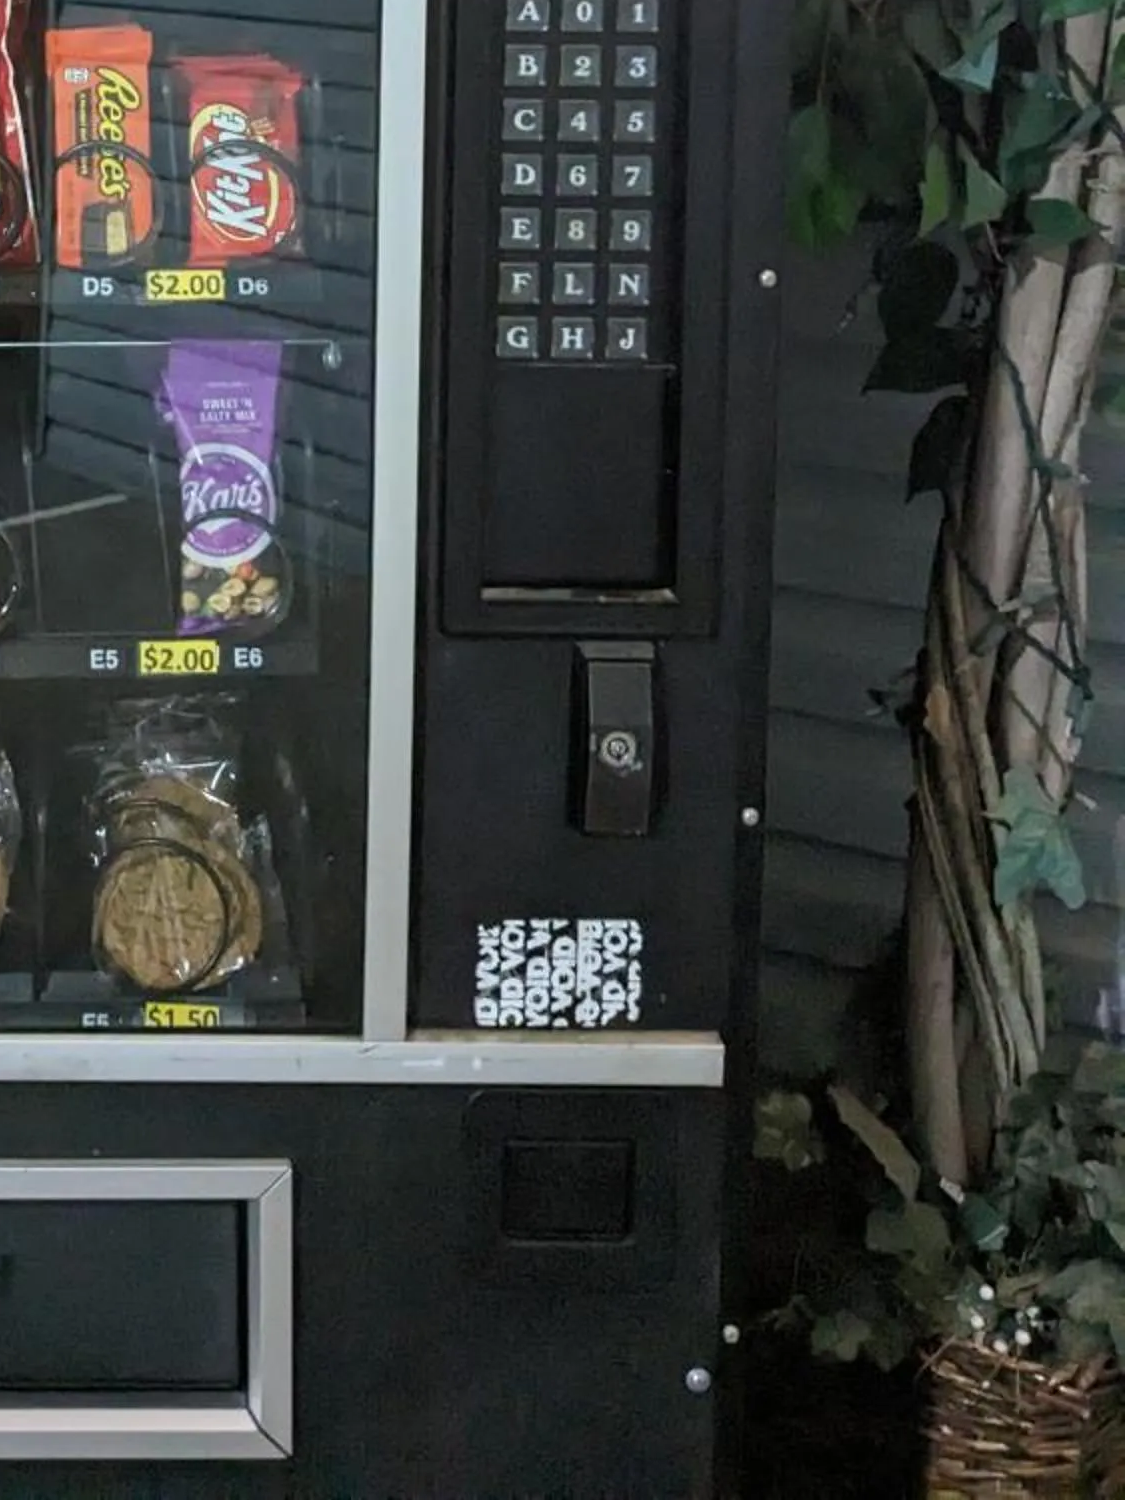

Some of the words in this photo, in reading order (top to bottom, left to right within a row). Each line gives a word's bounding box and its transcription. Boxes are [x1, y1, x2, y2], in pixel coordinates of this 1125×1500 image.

[517, 0, 540, 21] A
[576, 1, 593, 22] 0
[633, 3, 644, 23] 1
[518, 54, 539, 76] B
[573, 56, 591, 77] 2
[629, 57, 647, 78] 3
[513, 109, 536, 131] C
[571, 111, 587, 132] 4
[627, 112, 644, 132] 5
[514, 163, 536, 185] D
[569, 165, 586, 187] 6
[624, 166, 641, 187] 7
[511, 217, 532, 240] E
[568, 219, 585, 241] 8
[623, 220, 640, 241] 9
[82, 277, 114, 296] D5
[149, 273, 222, 297] $2.00
[238, 277, 269, 295] D6
[511, 272, 532, 294] F
[565, 273, 584, 295] L
[618, 273, 640, 296] N
[506, 326, 529, 349] G
[561, 327, 585, 349] H
[619, 328, 635, 350] J
[202, 398, 234, 411] SWEET
[199, 411, 231, 424] SALTY
[235, 410, 257, 423] MIX
[183, 472, 263, 522] Kar's
[90, 649, 119, 670] E5
[142, 644, 215, 672] $2.00
[234, 648, 264, 669] E6
[551, 936, 576, 1013] VOID
[149, 1005, 219, 1028] $150
